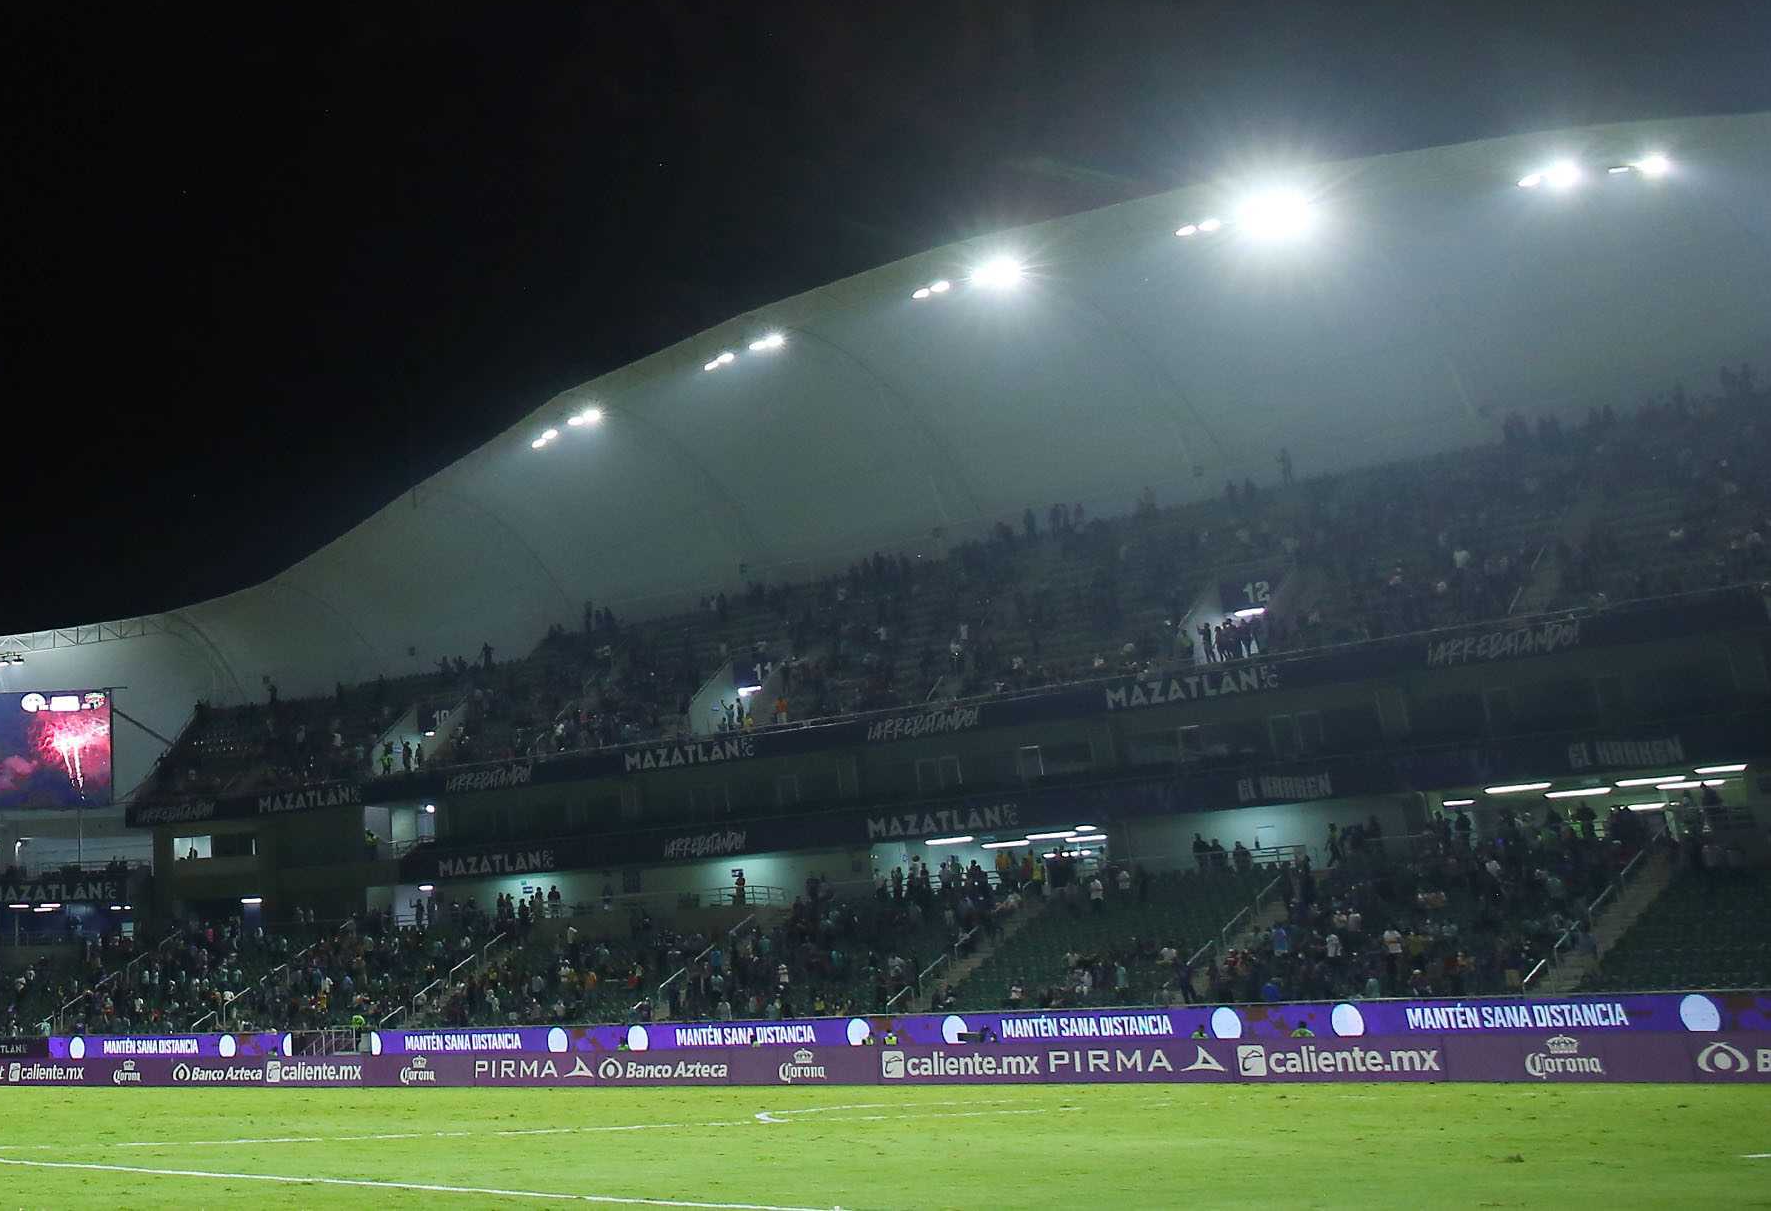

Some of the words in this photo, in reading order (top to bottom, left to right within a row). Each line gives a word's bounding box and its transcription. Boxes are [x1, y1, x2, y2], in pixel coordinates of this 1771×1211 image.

[1243, 580, 1270, 603] 12
[1002, 1015, 1057, 1038] MANTÉN
[1060, 1018, 1098, 1038] SANA
[1100, 1016, 1173, 1037] DISTANCIA
[1405, 1004, 1480, 1030] MANTÉN
[1483, 1004, 1533, 1030] SANA
[1534, 1003, 1630, 1028] DISTANCIA
[103, 1037, 134, 1054] MANTÉN
[136, 1039, 158, 1054] SANA
[159, 1038, 199, 1053] DISTANCIA
[404, 1033, 442, 1052] MANTÉN
[444, 1034, 471, 1052] SANA
[472, 1032, 522, 1051] DISTANCIA
[676, 1025, 722, 1046] MANTÉN
[756, 1025, 816, 1044] DISTANCIA
[474, 1060, 558, 1079] PIRMA
[626, 1062, 672, 1078] Banco
[673, 1061, 728, 1078] Azteca
[907, 1052, 1040, 1076] caliente.mx
[1048, 1048, 1174, 1073] PIRMA
[1269, 1046, 1440, 1073] caliente.mx
[1524, 1052, 1603, 1079] Corona
[21, 1063, 84, 1081] caliente.mx
[112, 1069, 142, 1085] Corona
[191, 1065, 223, 1082] Banco
[224, 1066, 263, 1083] Azteca
[281, 1061, 362, 1081] caliente.mx
[400, 1067, 436, 1085] Corona
[779, 1064, 826, 1084] Corona
